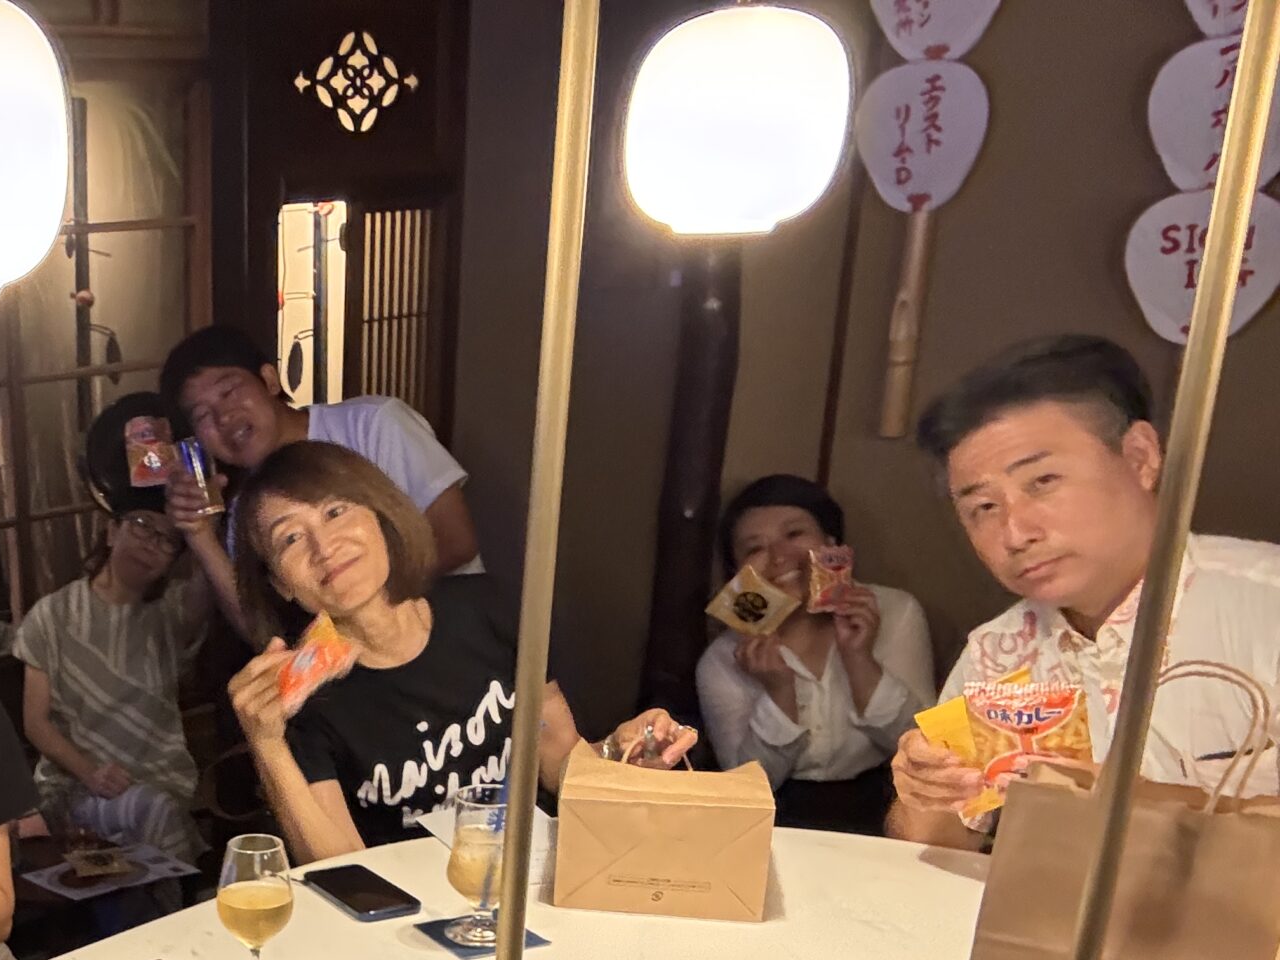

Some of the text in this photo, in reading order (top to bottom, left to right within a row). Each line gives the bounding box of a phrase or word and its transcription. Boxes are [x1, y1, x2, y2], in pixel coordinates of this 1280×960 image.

[920, 73, 946, 154] エクスト
[986, 706, 1062, 725] 味カレー
